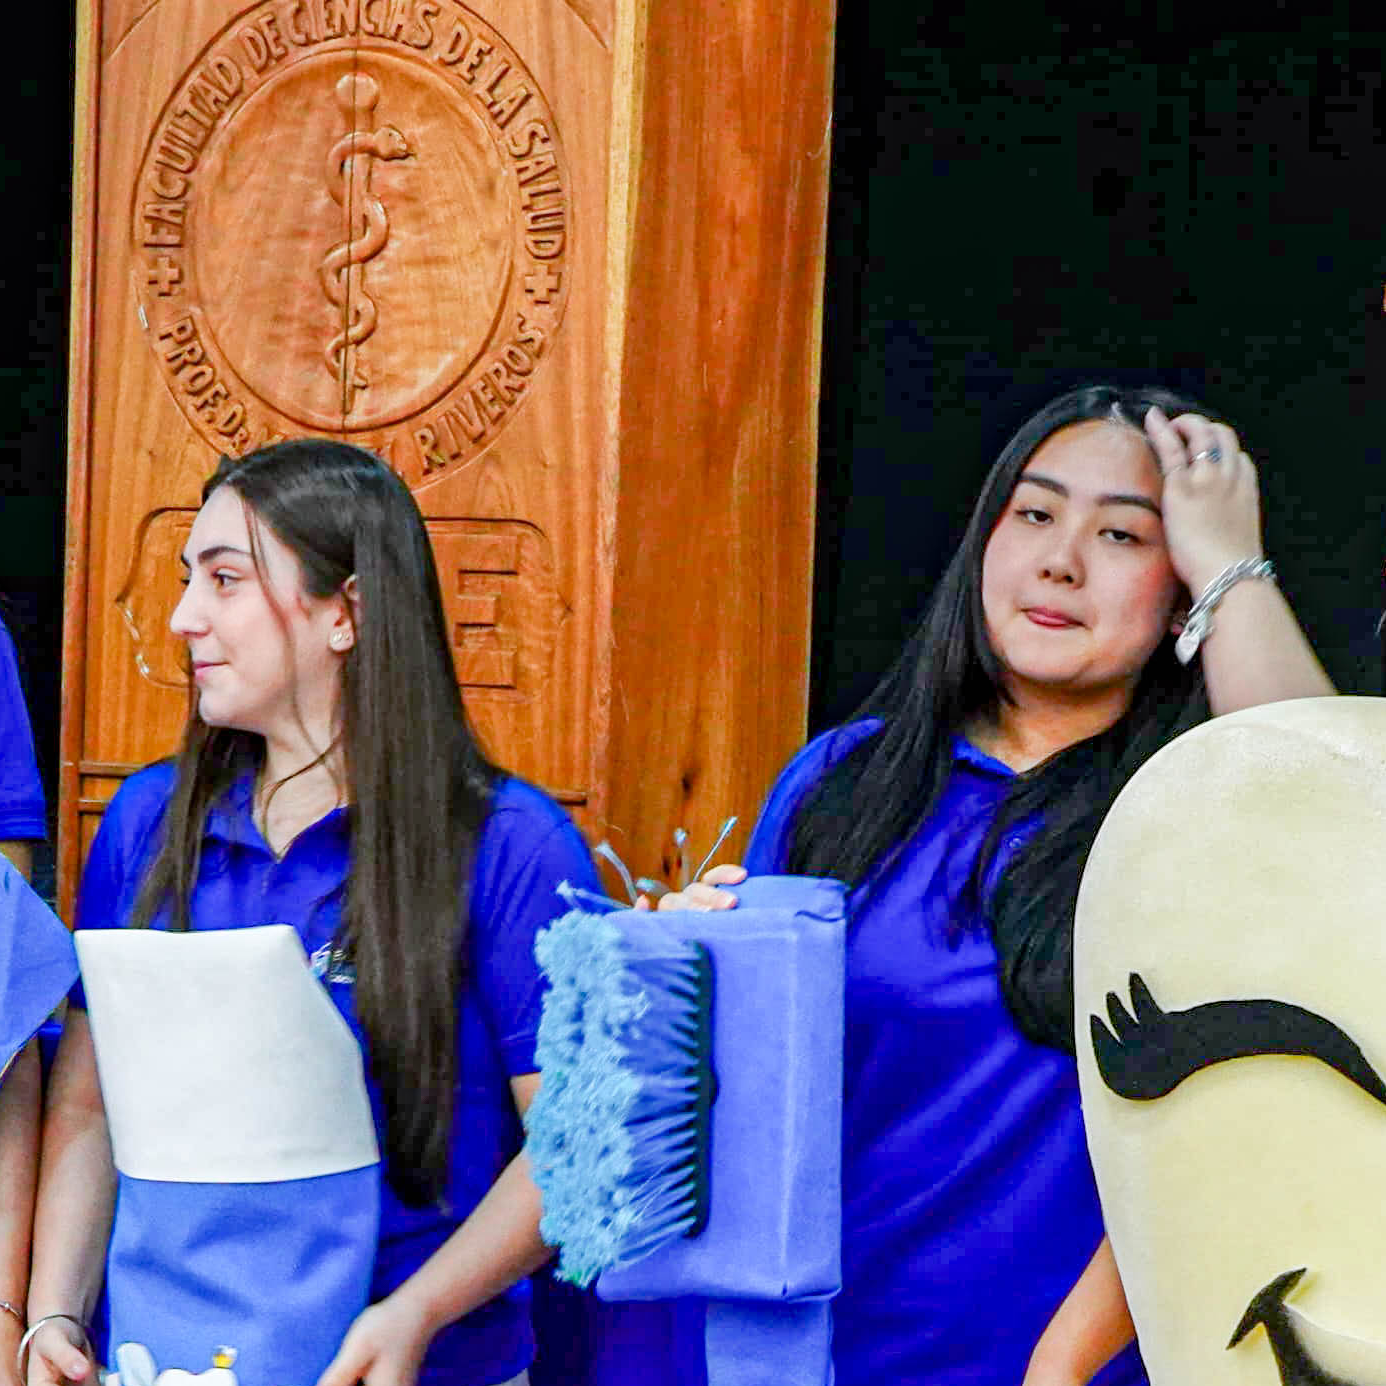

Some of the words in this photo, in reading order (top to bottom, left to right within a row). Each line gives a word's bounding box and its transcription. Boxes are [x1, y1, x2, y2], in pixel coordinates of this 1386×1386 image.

[143, 55, 244, 249] FACULTAD
[237, 12, 289, 76] DE
[437, 17, 495, 85] DE
[476, 57, 533, 130] LA
[508, 119, 567, 260] SALUD
[413, 312, 546, 477] RIVEROS
